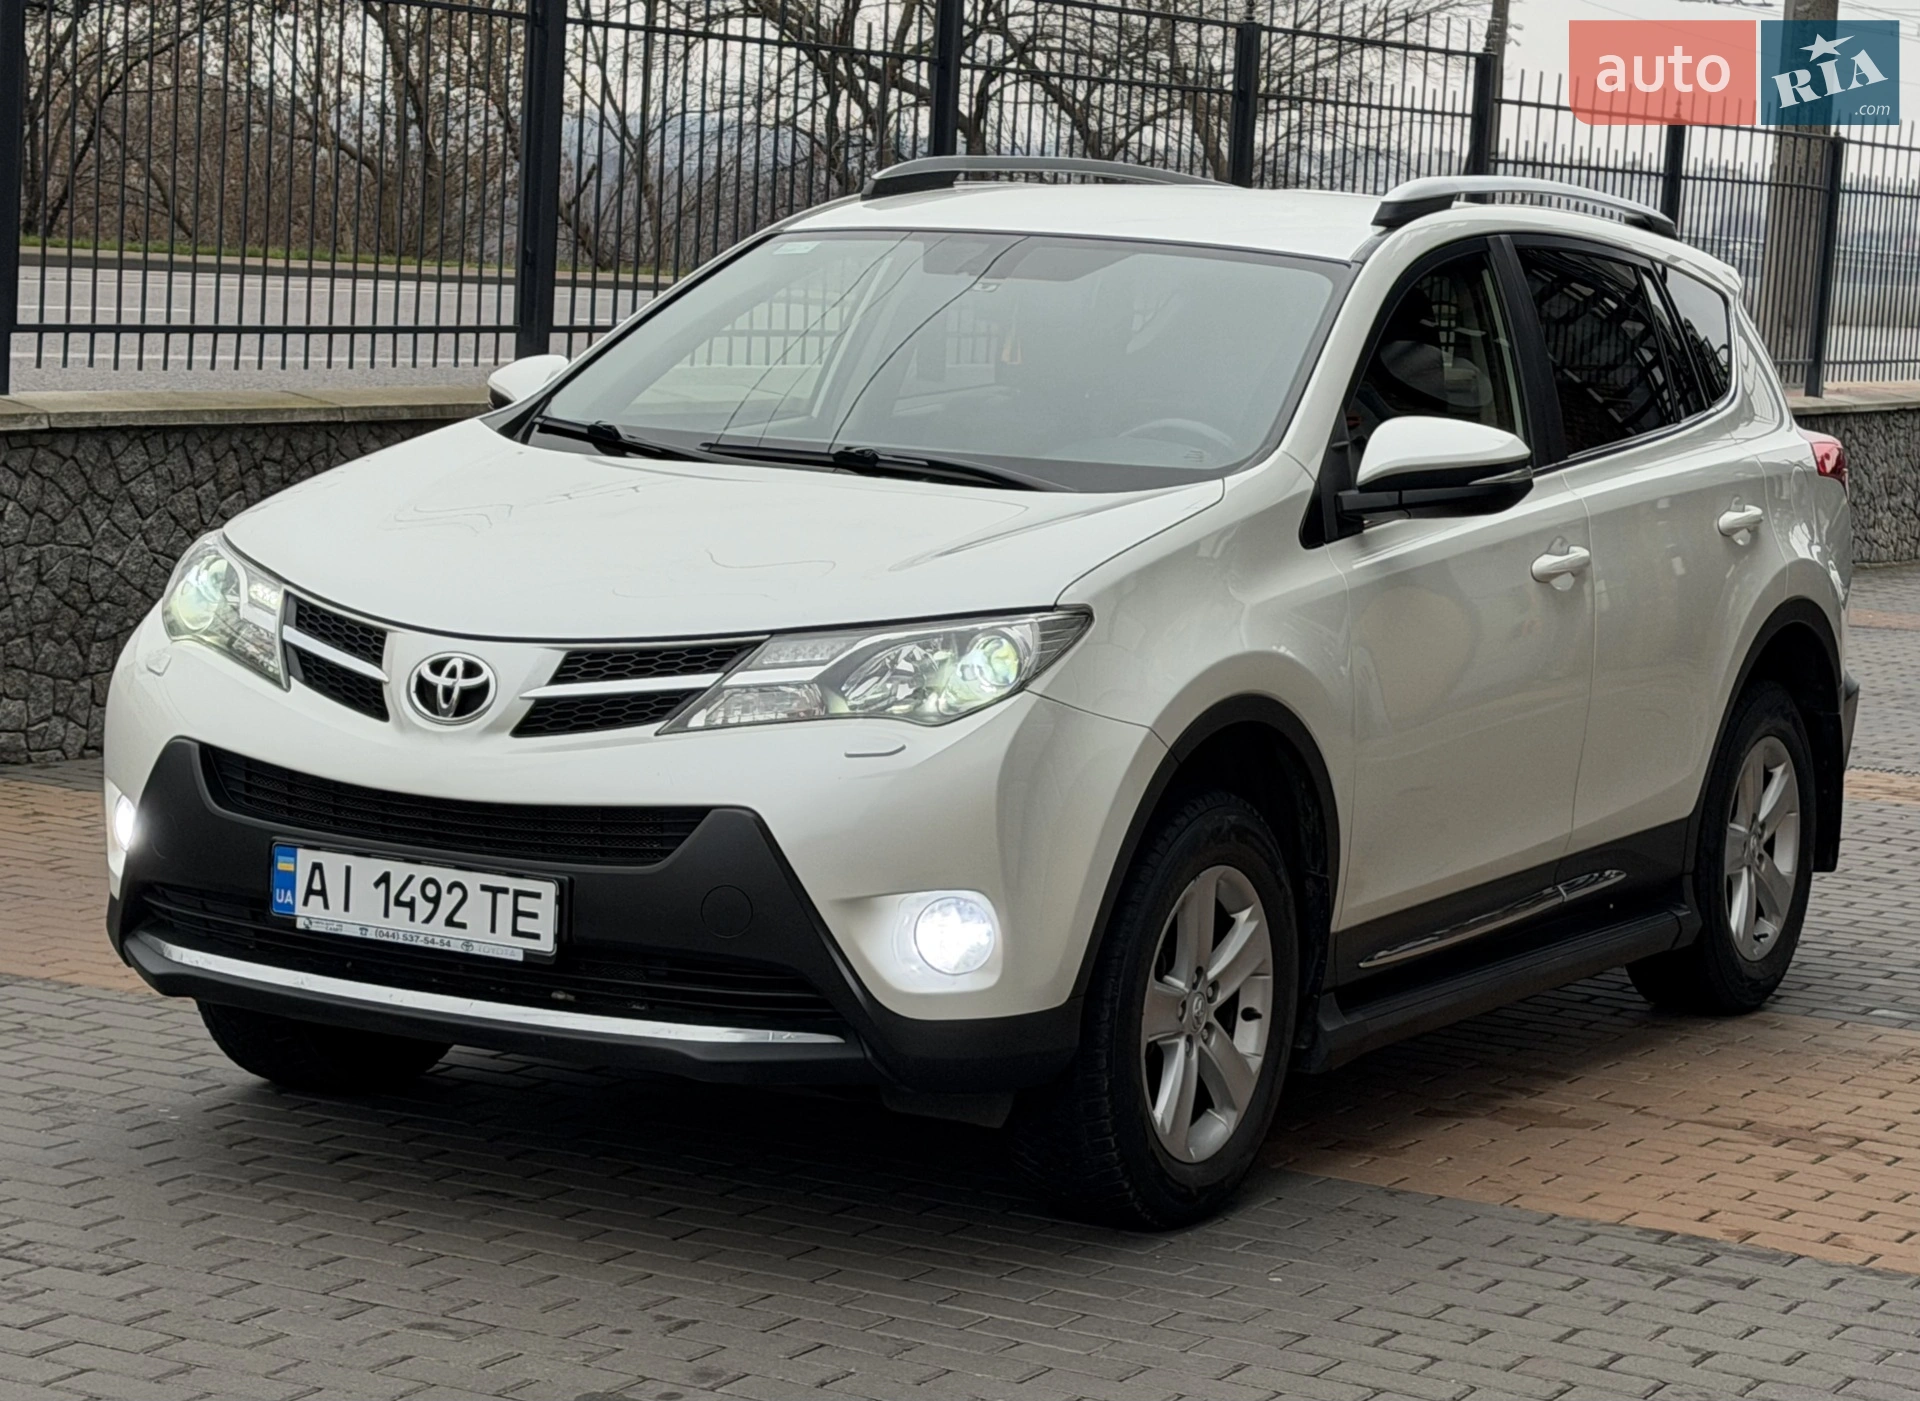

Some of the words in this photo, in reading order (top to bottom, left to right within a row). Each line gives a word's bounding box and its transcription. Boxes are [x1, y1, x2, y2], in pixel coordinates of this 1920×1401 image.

[275, 888, 294, 905] UA
[302, 861, 352, 913] AI
[373, 870, 469, 931] 1492
[479, 883, 542, 941] TE
[374, 928, 400, 940] (044)
[402, 933, 452, 948] 537-54-54
